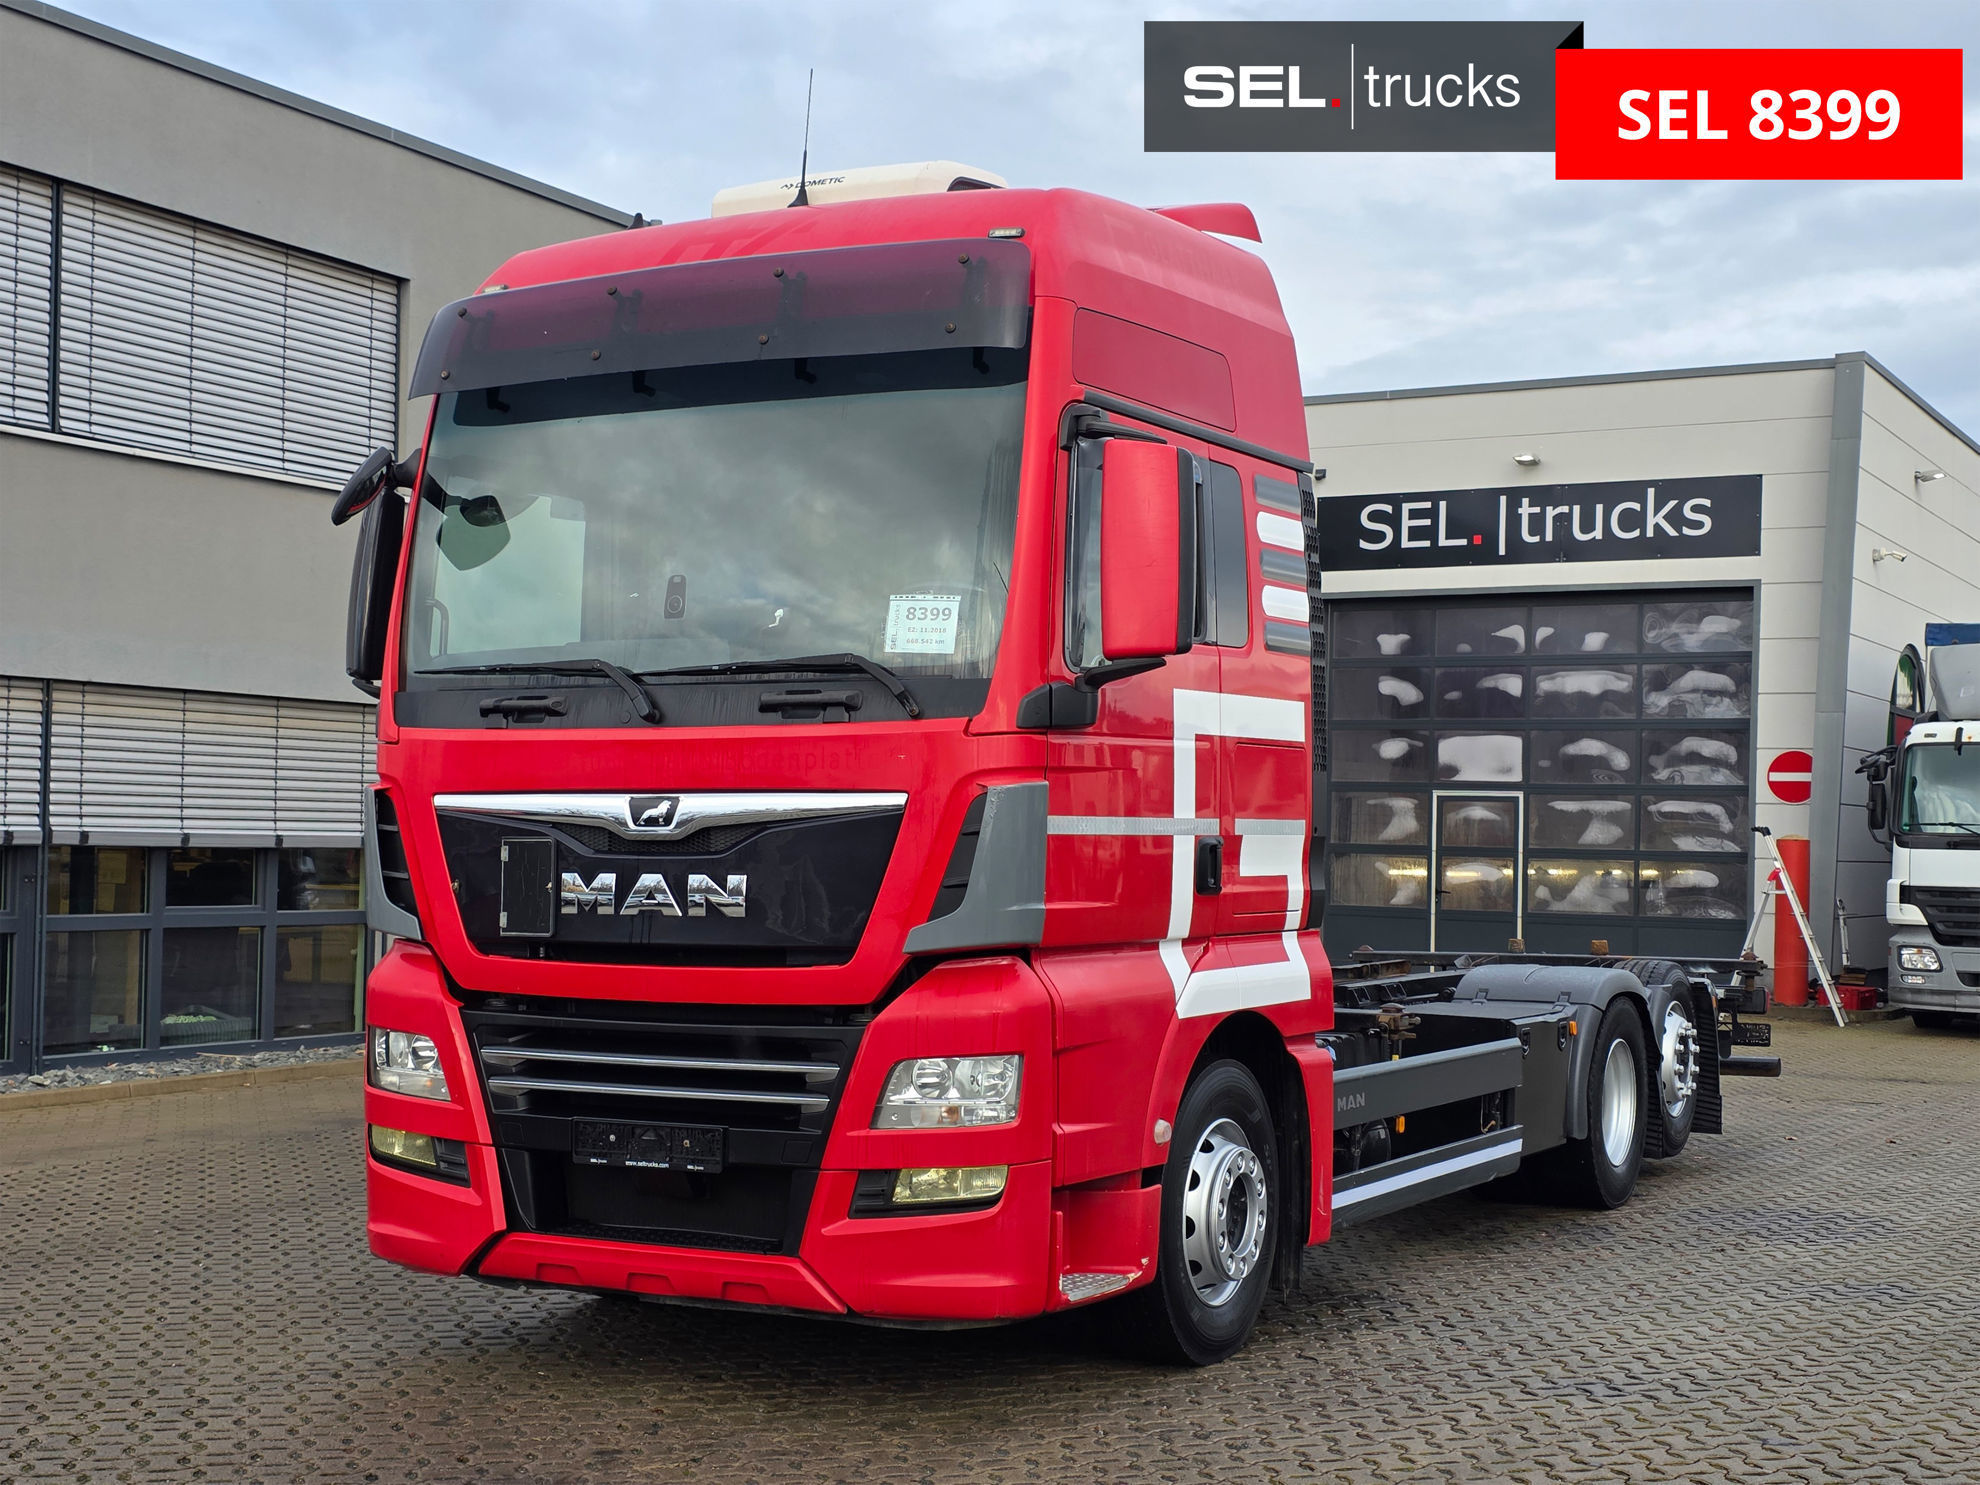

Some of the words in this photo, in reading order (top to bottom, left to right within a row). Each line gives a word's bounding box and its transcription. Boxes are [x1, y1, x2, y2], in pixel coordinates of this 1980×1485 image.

[795, 176, 846, 189] DOMETIC
[1518, 487, 1713, 544] trucks
[905, 606, 952, 621] 8399
[560, 872, 748, 918] MAN
[1337, 1092, 1366, 1112] MAN
